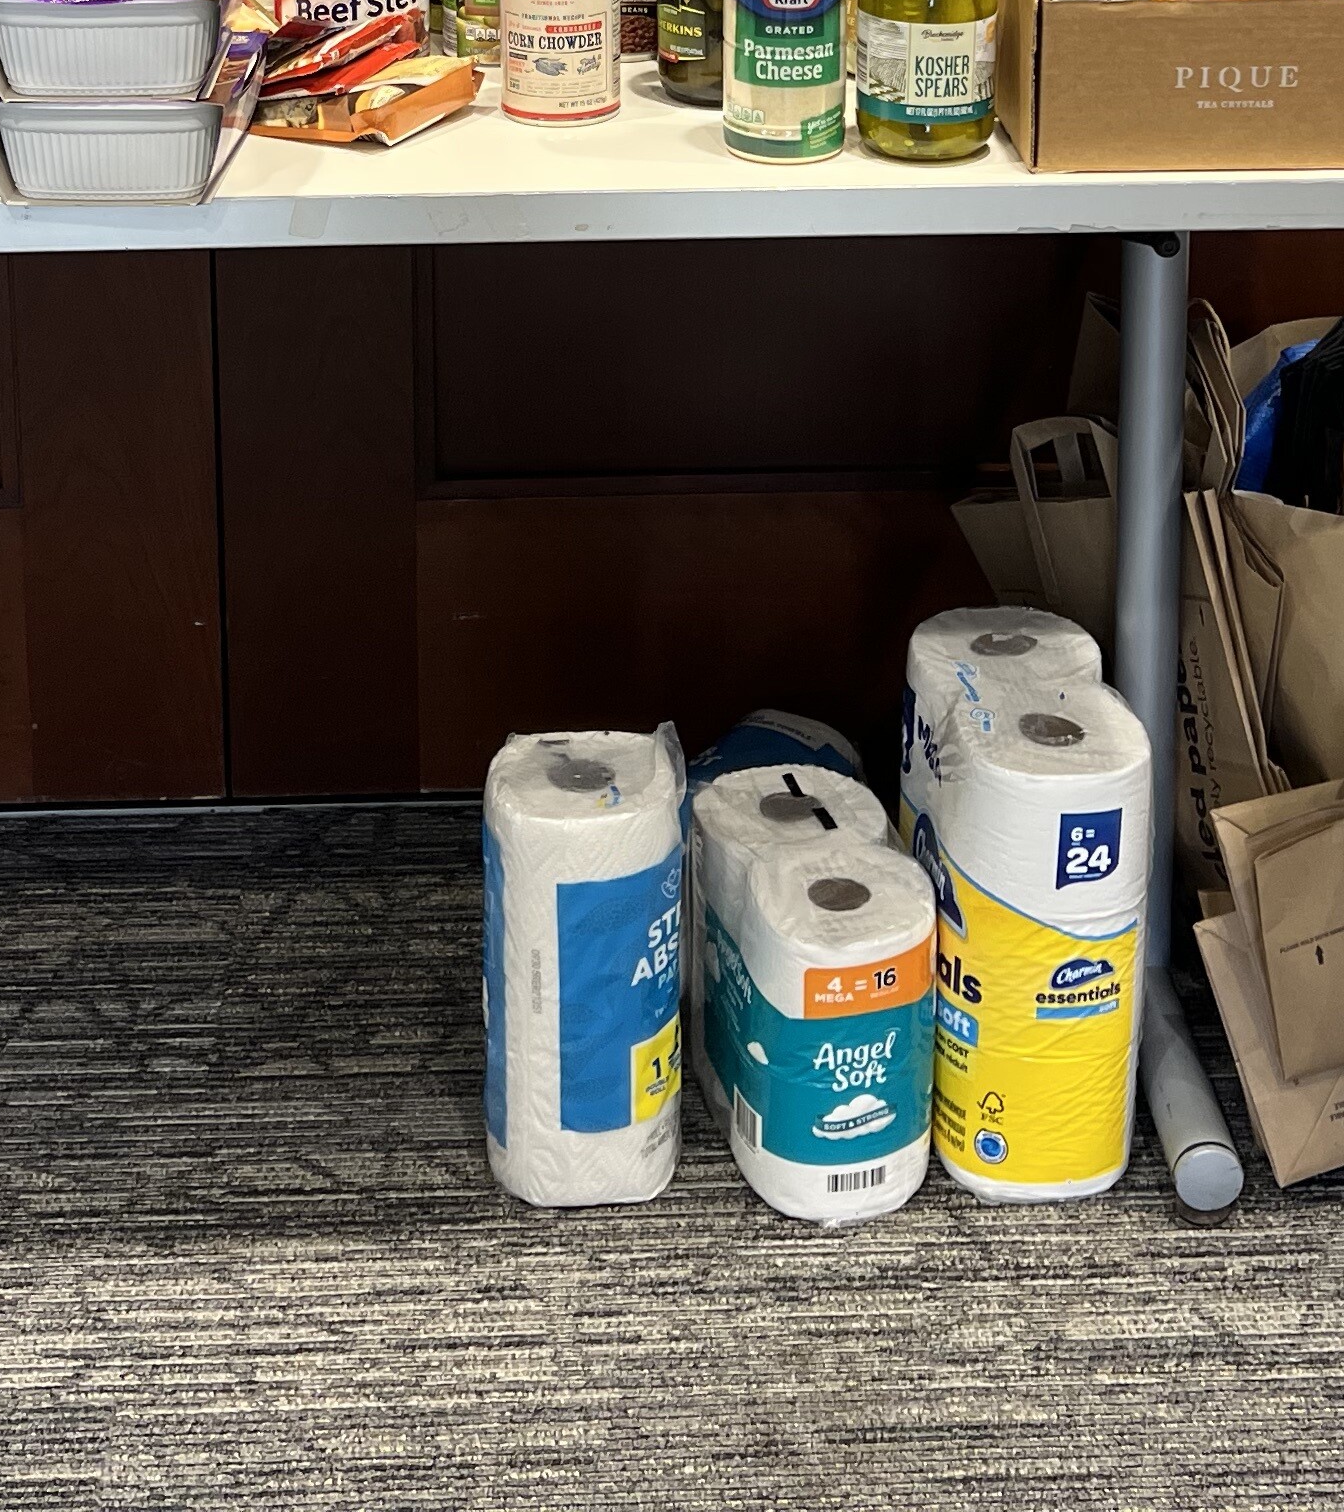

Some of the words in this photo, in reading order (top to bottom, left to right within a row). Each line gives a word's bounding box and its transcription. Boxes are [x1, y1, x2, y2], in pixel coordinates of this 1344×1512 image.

[508, 31, 534, 50] CORN
[539, 32, 602, 50] CHOWDER
[766, 26, 814, 34] GRATED
[744, 39, 834, 60] Parmesan
[756, 61, 822, 80] Cheese
[915, 55, 969, 76] KOSHER
[915, 77, 968, 97] SPEARS
[1175, 66, 1299, 92] PIQUE
[1197, 101, 1217, 109] TEA
[1221, 100, 1273, 108] CRYSTALS
[1066, 845, 1111, 874] 24
[827, 977, 843, 992] 4
[874, 968, 897, 989] 16
[1056, 962, 1103, 983] Charmin
[814, 992, 854, 1003] MEGA
[1036, 982, 1121, 1004] essentials
[813, 1031, 896, 1070] Angel
[832, 1060, 887, 1092] Soft
[824, 1121, 846, 1131] SOFT
[856, 1108, 889, 1126] STRONG
